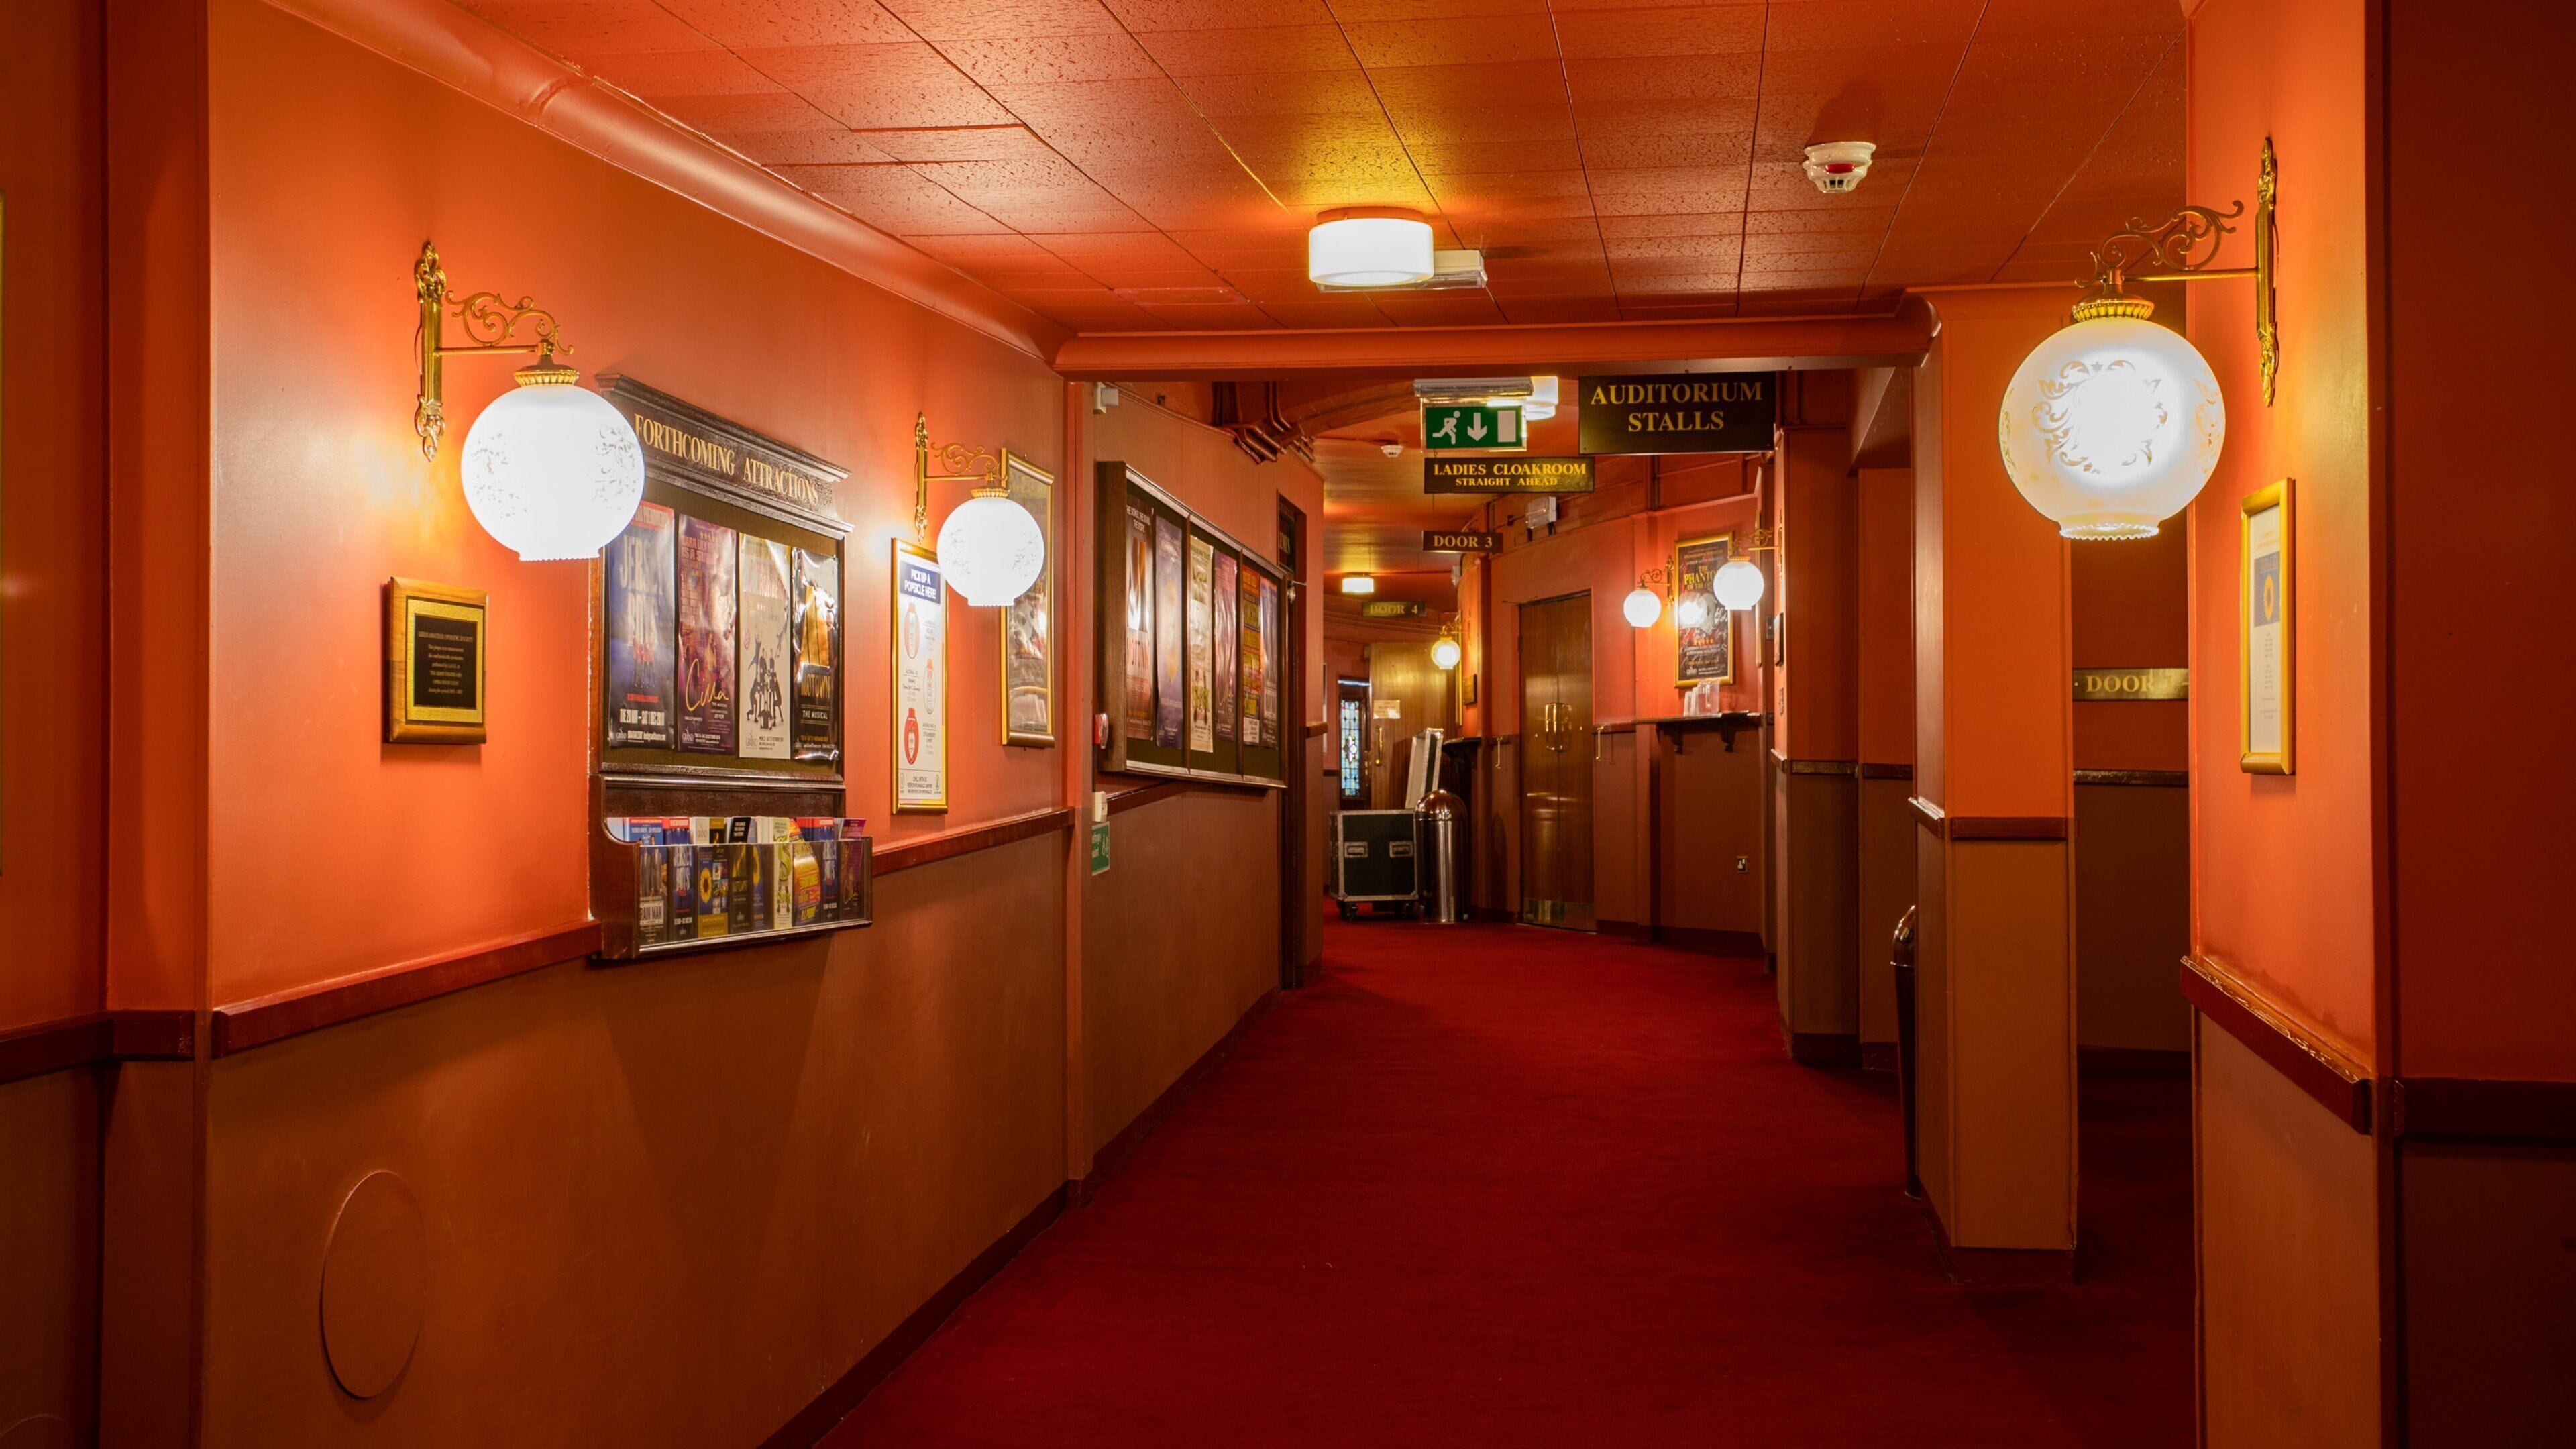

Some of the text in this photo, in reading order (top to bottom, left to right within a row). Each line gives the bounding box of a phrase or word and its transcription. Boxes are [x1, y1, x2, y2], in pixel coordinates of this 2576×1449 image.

[1591, 382, 1763, 405] AUDITORIUM
[1628, 411, 1724, 432] STALLS
[634, 413, 818, 506] FORTHCOMING ATTRACTIONS
[1434, 463, 1586, 476] LADIES CLOAKROOM
[1456, 478, 1558, 486] STRAIGHT AHEAD
[1433, 535, 1493, 549] DOOR 3
[1684, 570, 1717, 586] PHANTO
[1369, 604, 1418, 614] DOOR 4
[685, 658, 730, 712] Cilla
[2086, 675, 2155, 692] DOOR
[802, 710, 828, 720] THE MUSICAL
